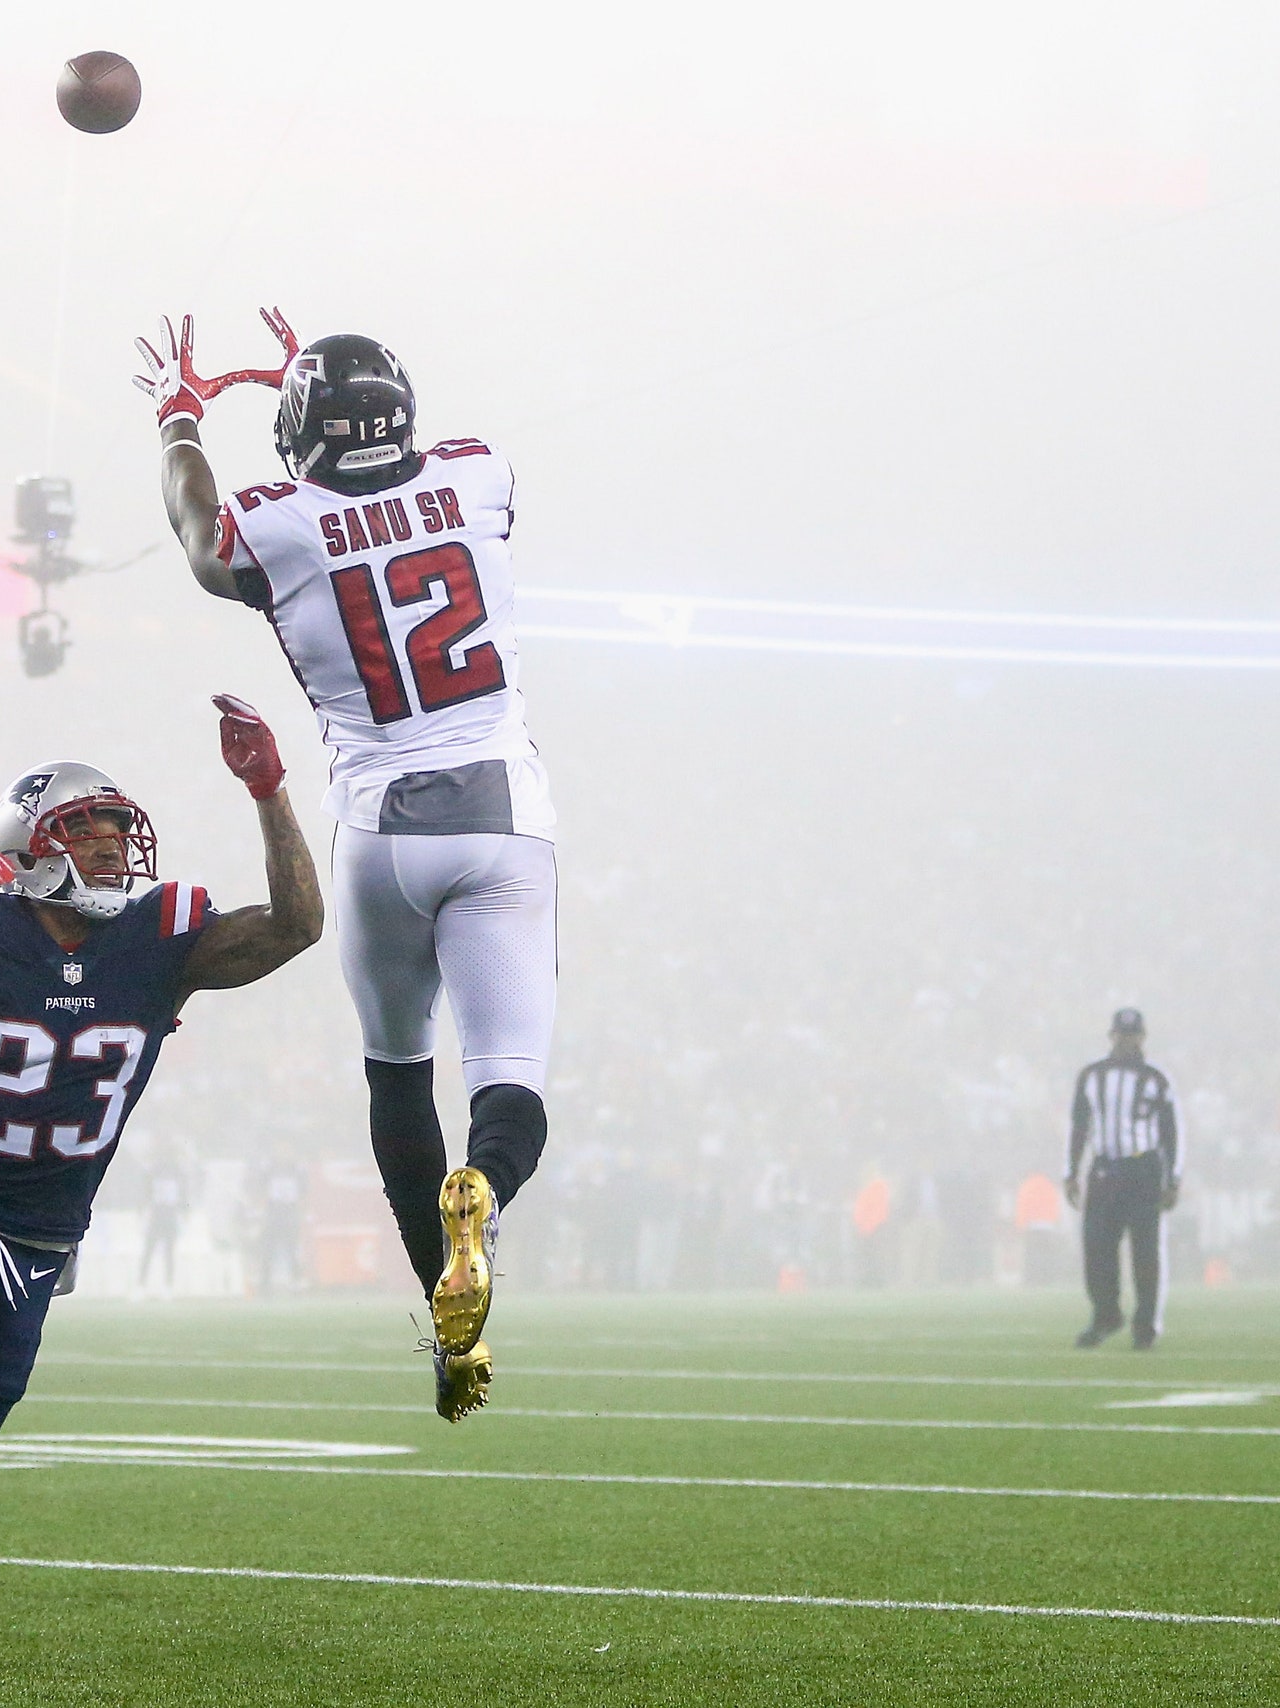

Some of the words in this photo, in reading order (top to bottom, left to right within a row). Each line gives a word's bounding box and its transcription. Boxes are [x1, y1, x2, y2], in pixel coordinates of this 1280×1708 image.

[359, 416, 387, 441] 12
[346, 449, 396, 461] FALCONS
[321, 498, 412, 556] SANU
[415, 487, 465, 533] SR
[329, 542, 506, 725] 12
[45, 997, 96, 1010] PATRIOTS
